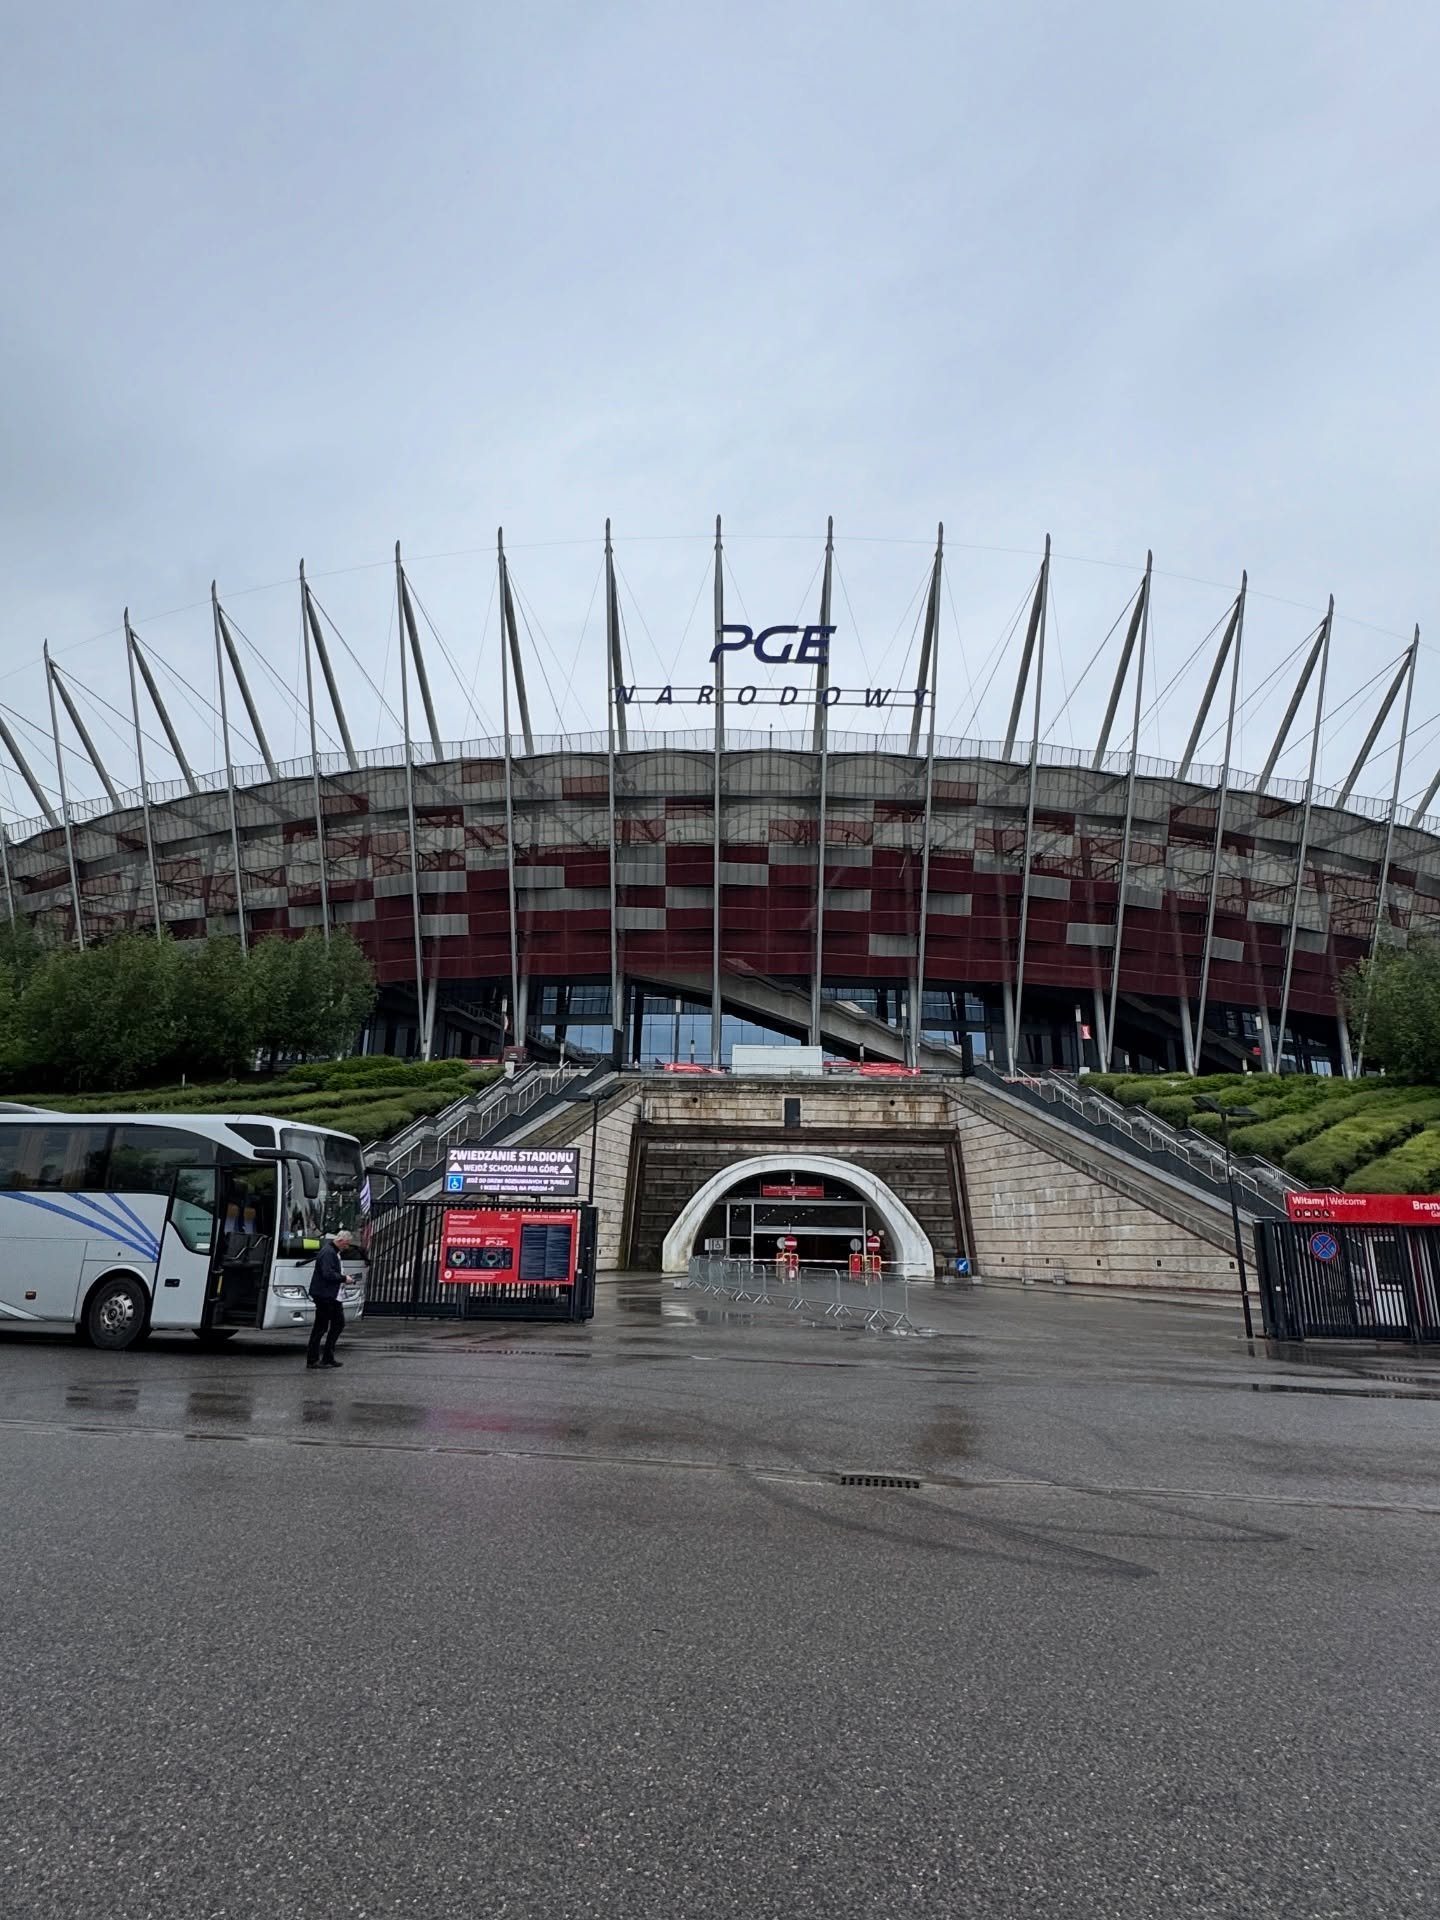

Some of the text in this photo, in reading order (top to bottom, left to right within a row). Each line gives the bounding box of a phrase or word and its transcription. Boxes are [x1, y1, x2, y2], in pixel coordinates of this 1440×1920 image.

[709, 624, 837, 664] PGE
[615, 685, 929, 707] NARODOWY
[449, 1149, 574, 1163] ZWIEDZANIE STADIONU
[463, 1162, 559, 1175] WEJDŹ SCHODAMI NA GÓRĘ
[1292, 1196, 1367, 1207] Witamy Welcome
